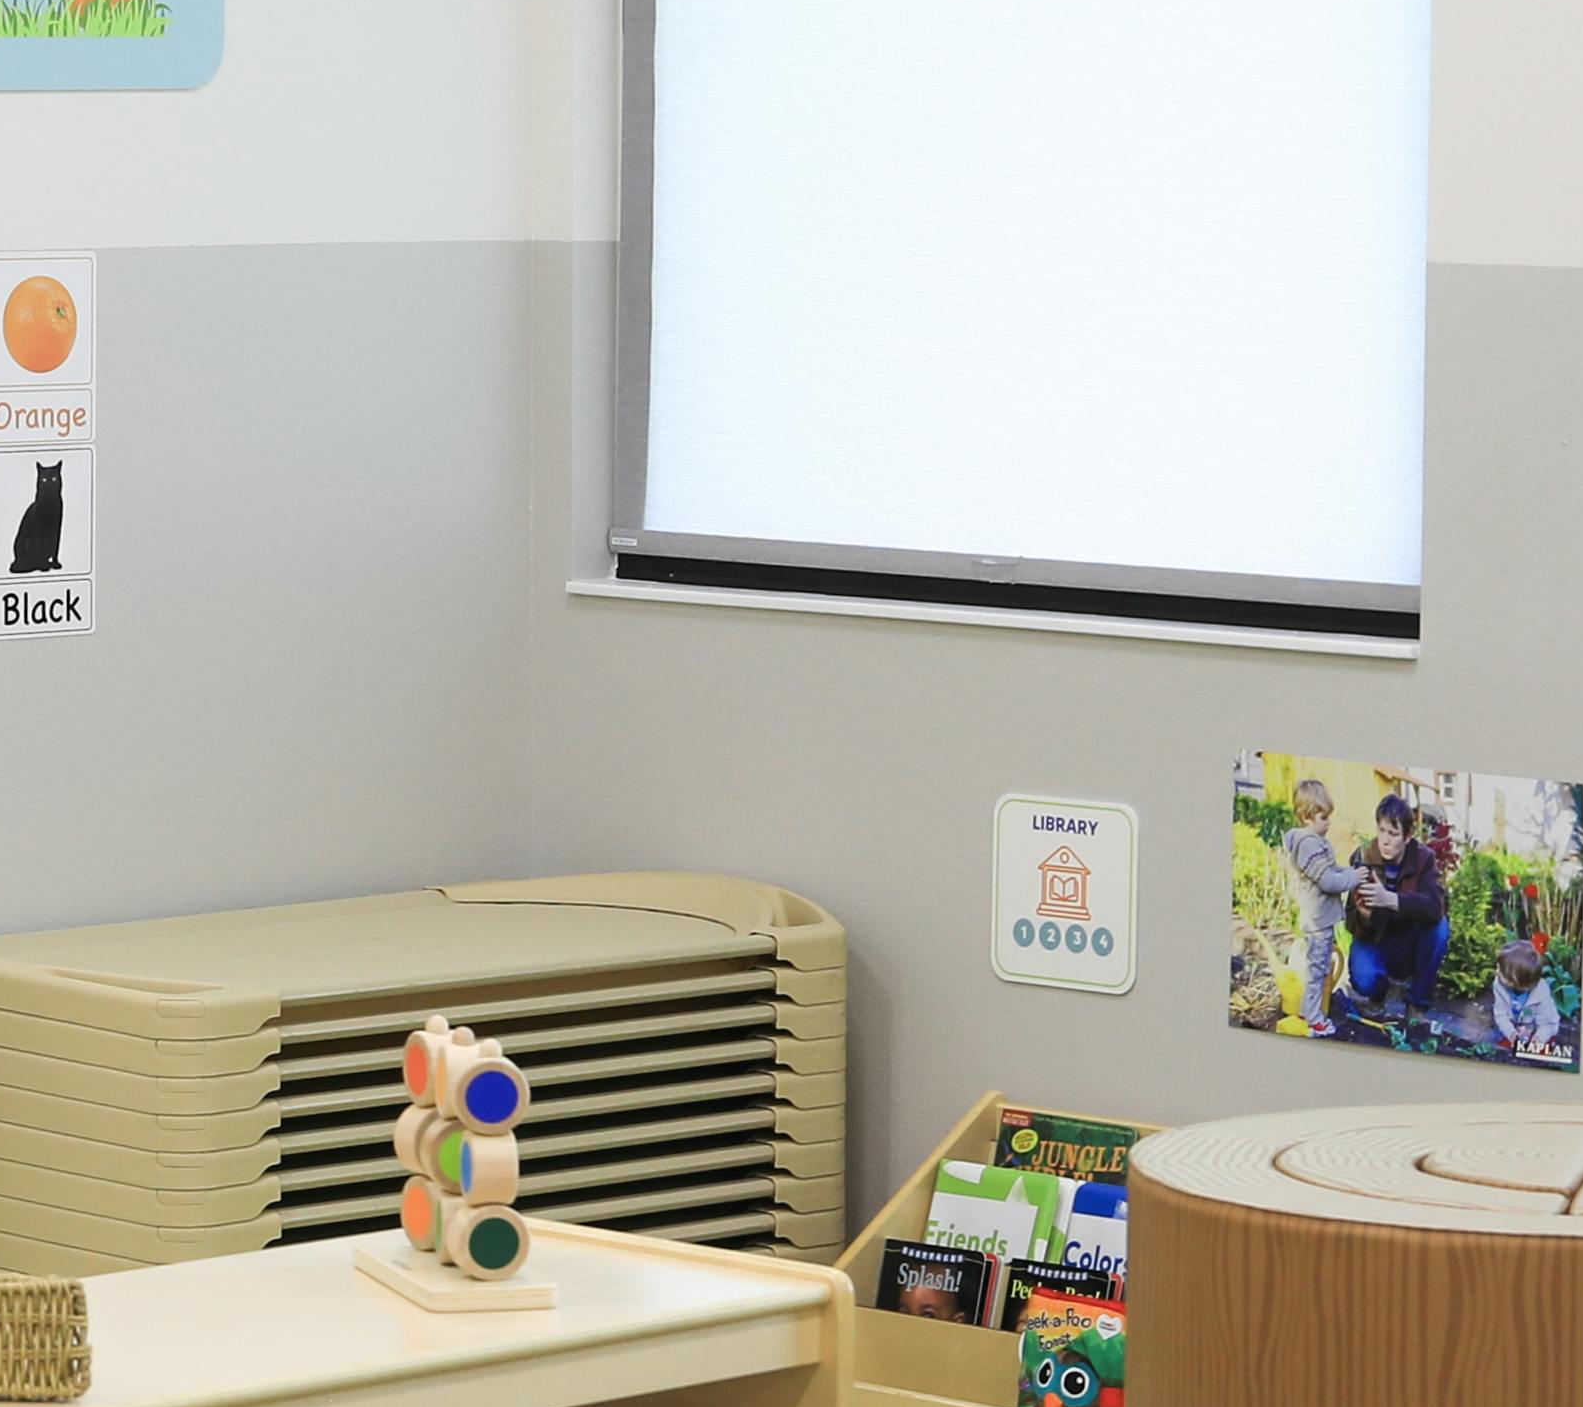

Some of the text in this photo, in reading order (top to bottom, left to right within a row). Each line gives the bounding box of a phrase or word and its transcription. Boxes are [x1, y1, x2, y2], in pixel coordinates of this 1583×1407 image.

[2, 589, 82, 625] Black
[1032, 815, 1099, 836] LIBRARY
[1020, 926, 1108, 949] 1 2 3 4
[1516, 1040, 1573, 1057] KAPLAN
[1031, 1140, 1126, 1172] JUNGLE
[925, 1220, 1008, 1256] Friends
[897, 1262, 963, 1292] Splash!
